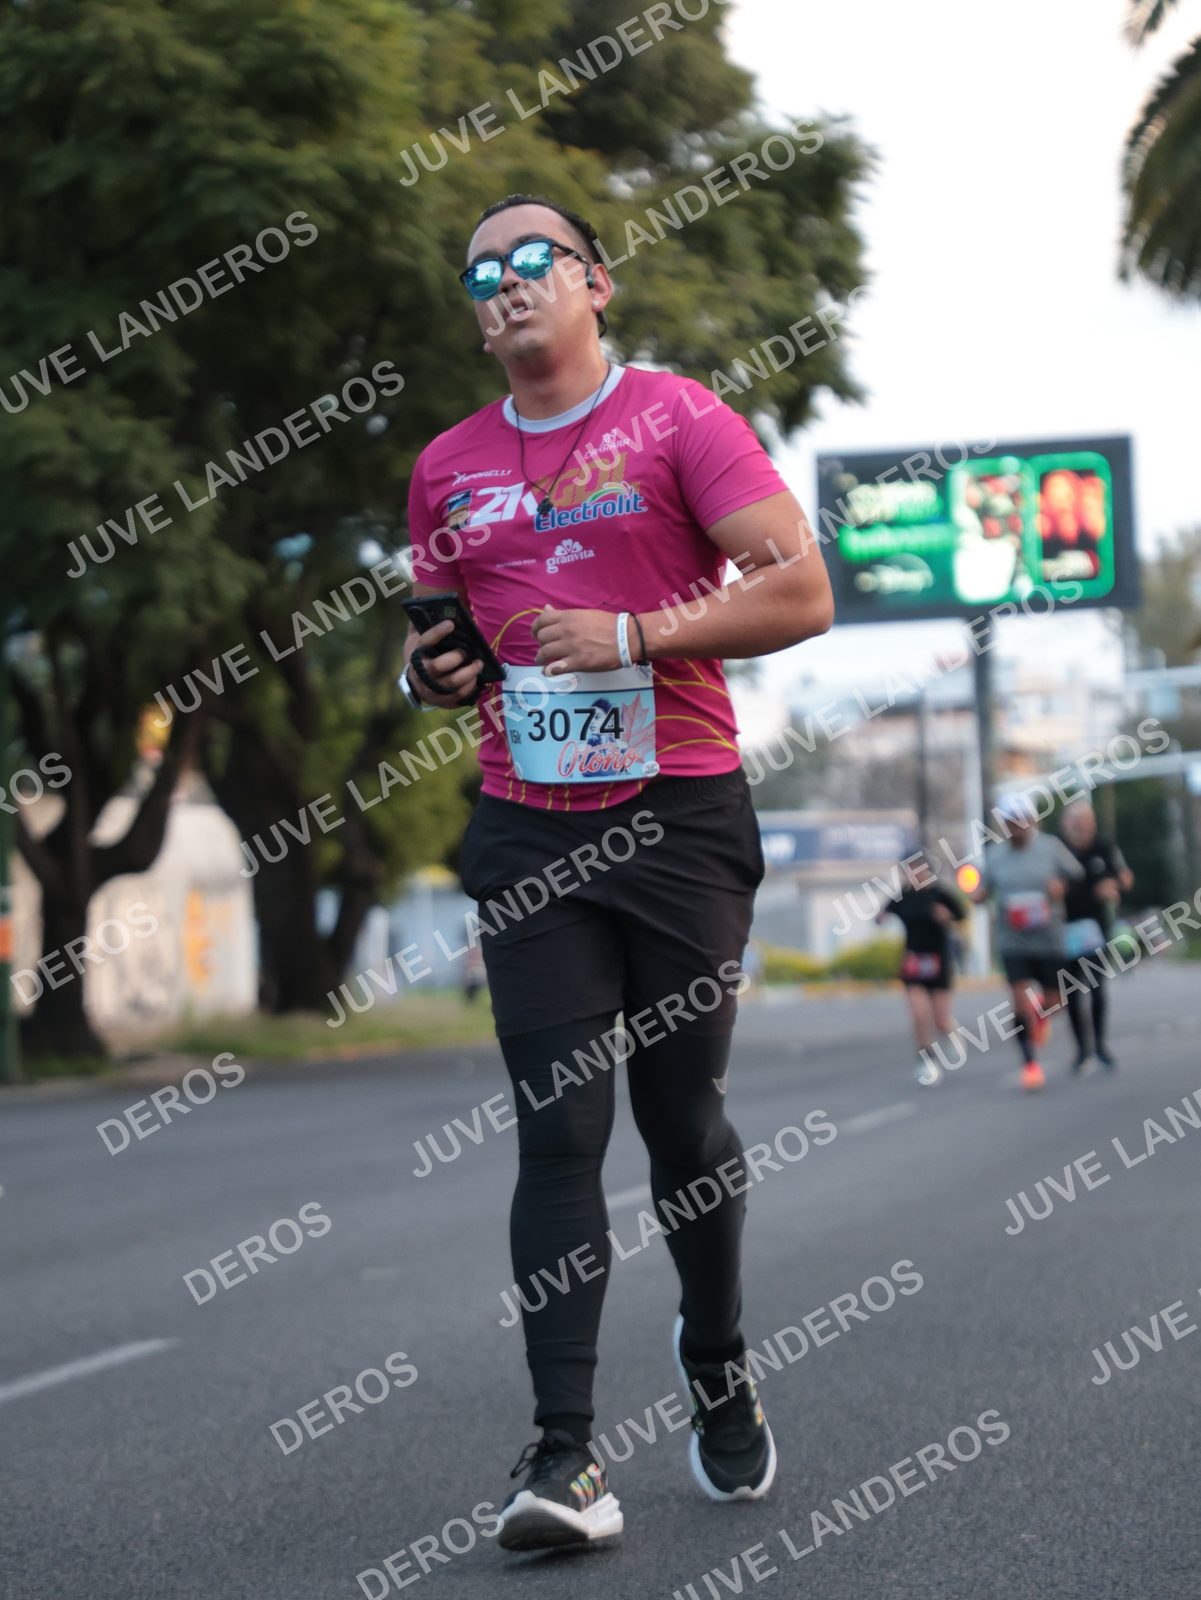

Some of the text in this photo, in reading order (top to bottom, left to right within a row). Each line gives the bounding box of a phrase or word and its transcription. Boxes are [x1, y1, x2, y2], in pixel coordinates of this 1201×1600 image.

[534, 489, 645, 532] Electrolit
[545, 549, 595, 574] granvita
[527, 706, 625, 742] 3074
